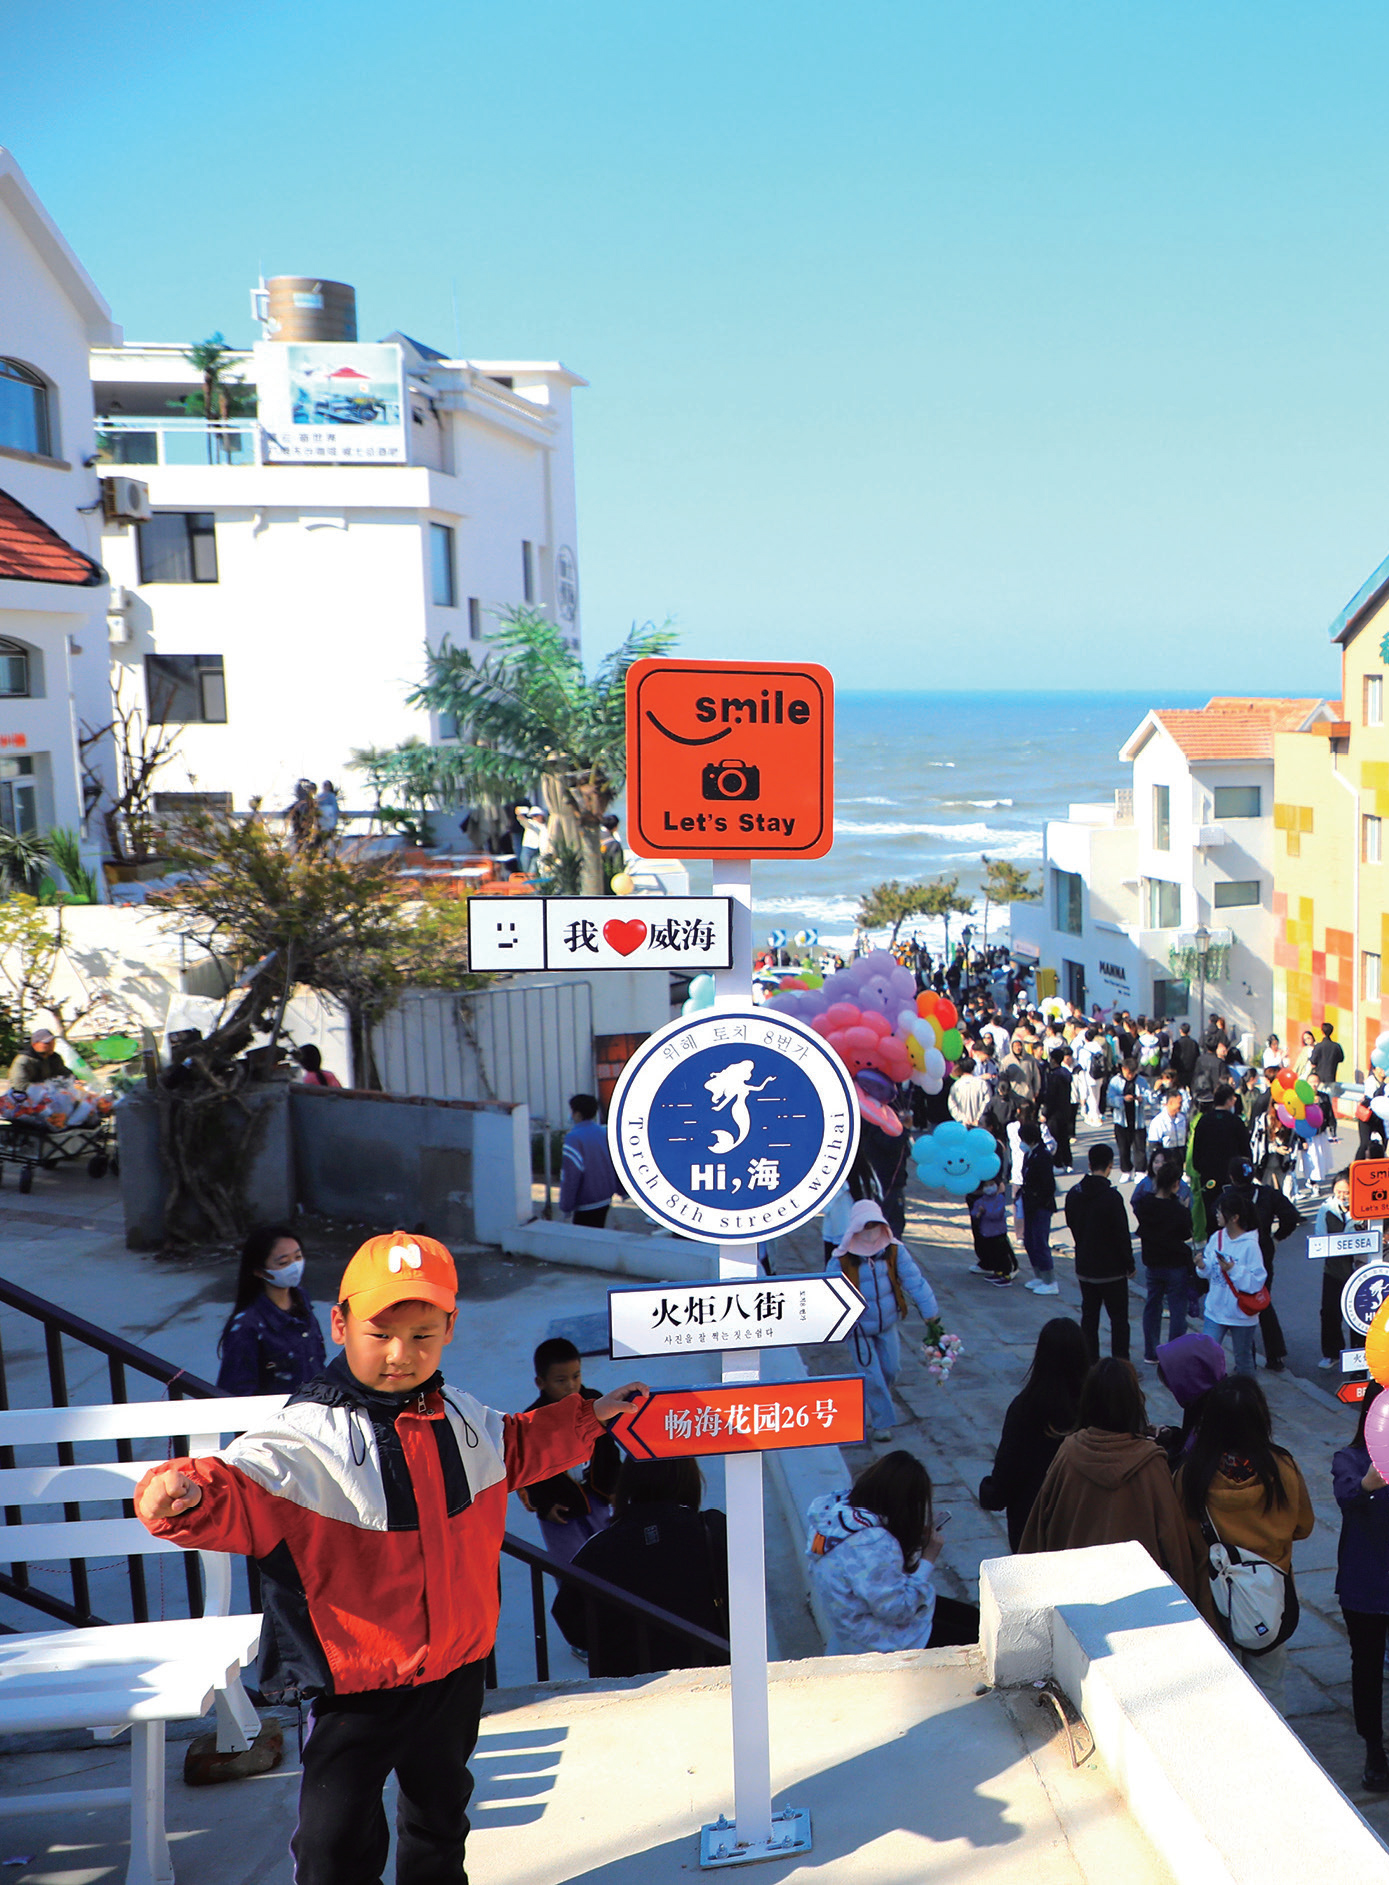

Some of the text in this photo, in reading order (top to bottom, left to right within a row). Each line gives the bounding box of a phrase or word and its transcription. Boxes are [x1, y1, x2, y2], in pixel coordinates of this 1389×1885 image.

[695, 689, 811, 725] smile
[663, 811, 796, 836] Let's Stay
[563, 918, 716, 952] 我 威海
[663, 1024, 809, 1061] 위해 토치 8번가
[628, 1112, 845, 1229] Torch 8th street weihai
[1361, 1204, 1379, 1212] Let's
[388, 1244, 421, 1273] N
[1337, 1238, 1371, 1250] SEE SEA
[651, 1291, 786, 1329] 火炬八街
[664, 1398, 838, 1440] 畅海花园26号
